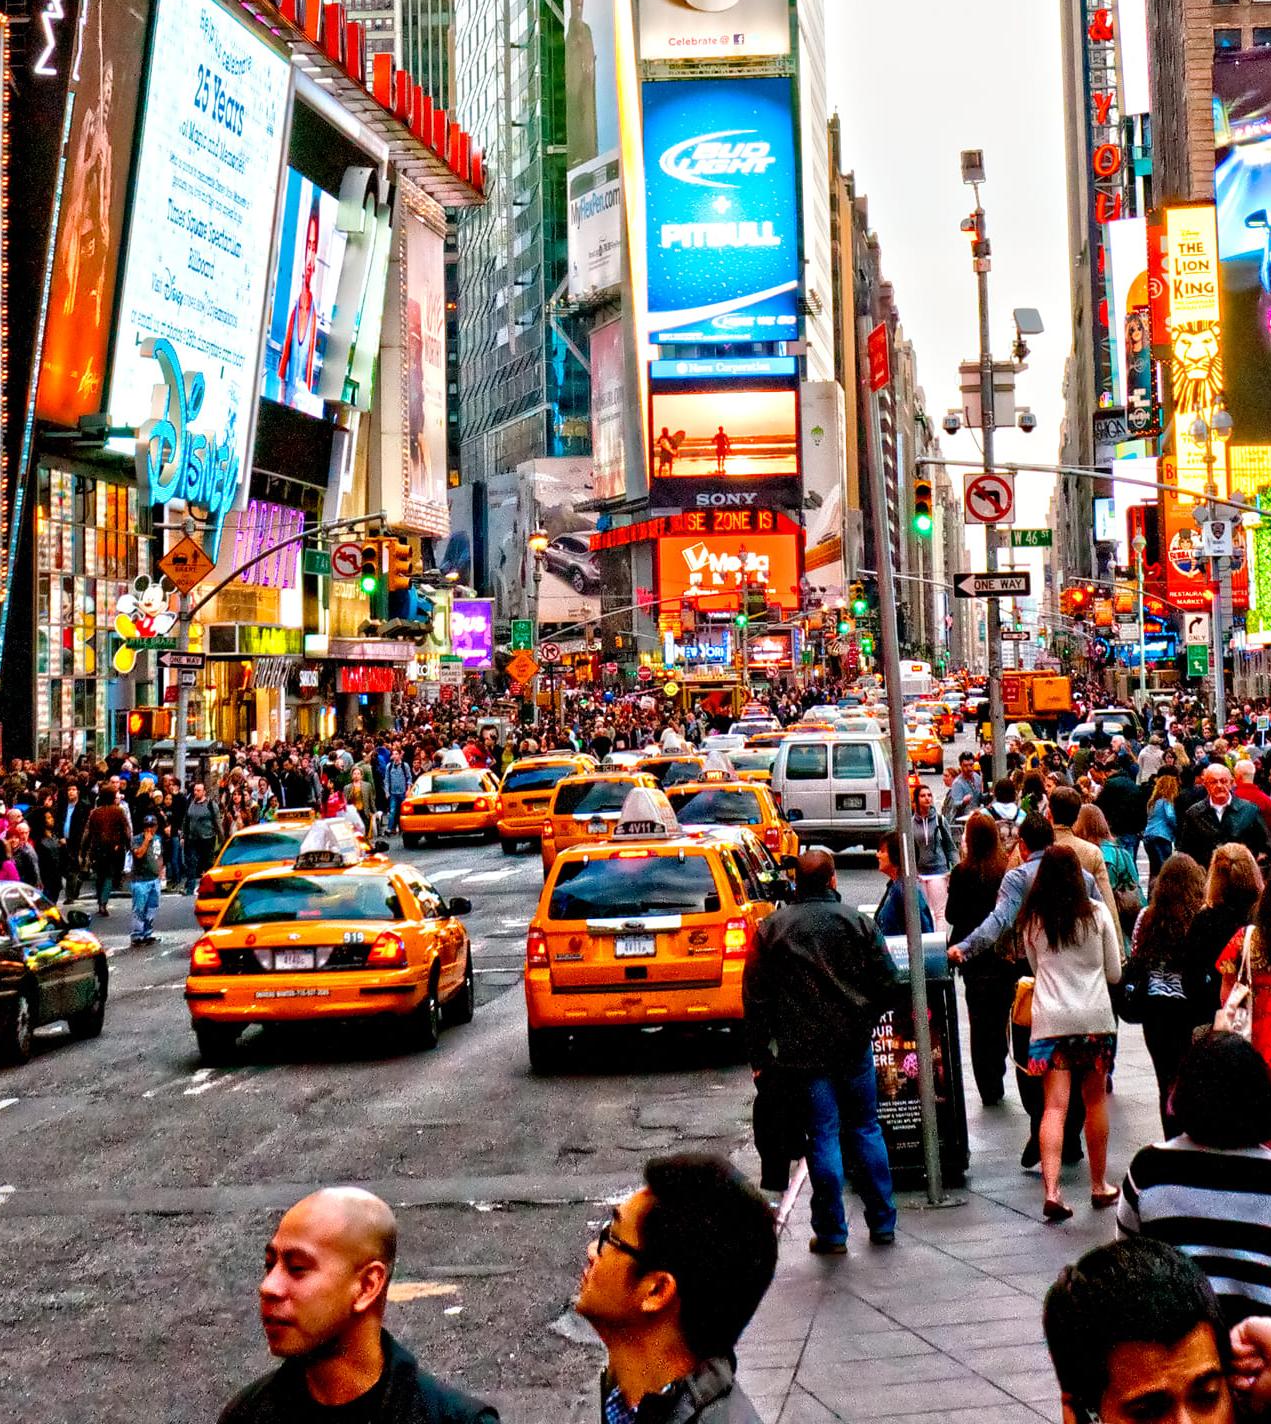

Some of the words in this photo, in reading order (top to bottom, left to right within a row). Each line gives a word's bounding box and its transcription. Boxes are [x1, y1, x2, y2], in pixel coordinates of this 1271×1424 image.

[668, 37, 717, 46] Celebrate
[194, 64, 210, 112] 25
[212, 75, 245, 137] Years
[692, 142, 770, 160] BUD
[679, 157, 776, 175] LIGHT
[661, 221, 781, 248] PITBULL
[1178, 242, 1203, 254] THE
[1175, 258, 1210, 276] LION
[1173, 279, 1214, 300] KING
[695, 492, 757, 506] SONY
[714, 511, 751, 530] ZONE
[759, 511, 772, 529] IS
[1014, 531, 1022, 544] W
[1025, 531, 1038, 544] 46
[1040, 530, 1049, 538] ST
[974, 580, 995, 591] ONE
[1000, 578, 1023, 589] WAY
[1187, 631, 1208, 642] ONLY
[169, 655, 183, 663] ONE
[186, 655, 200, 663] WAY
[628, 823, 651, 833] 4V11
[344, 933, 364, 943] 919
